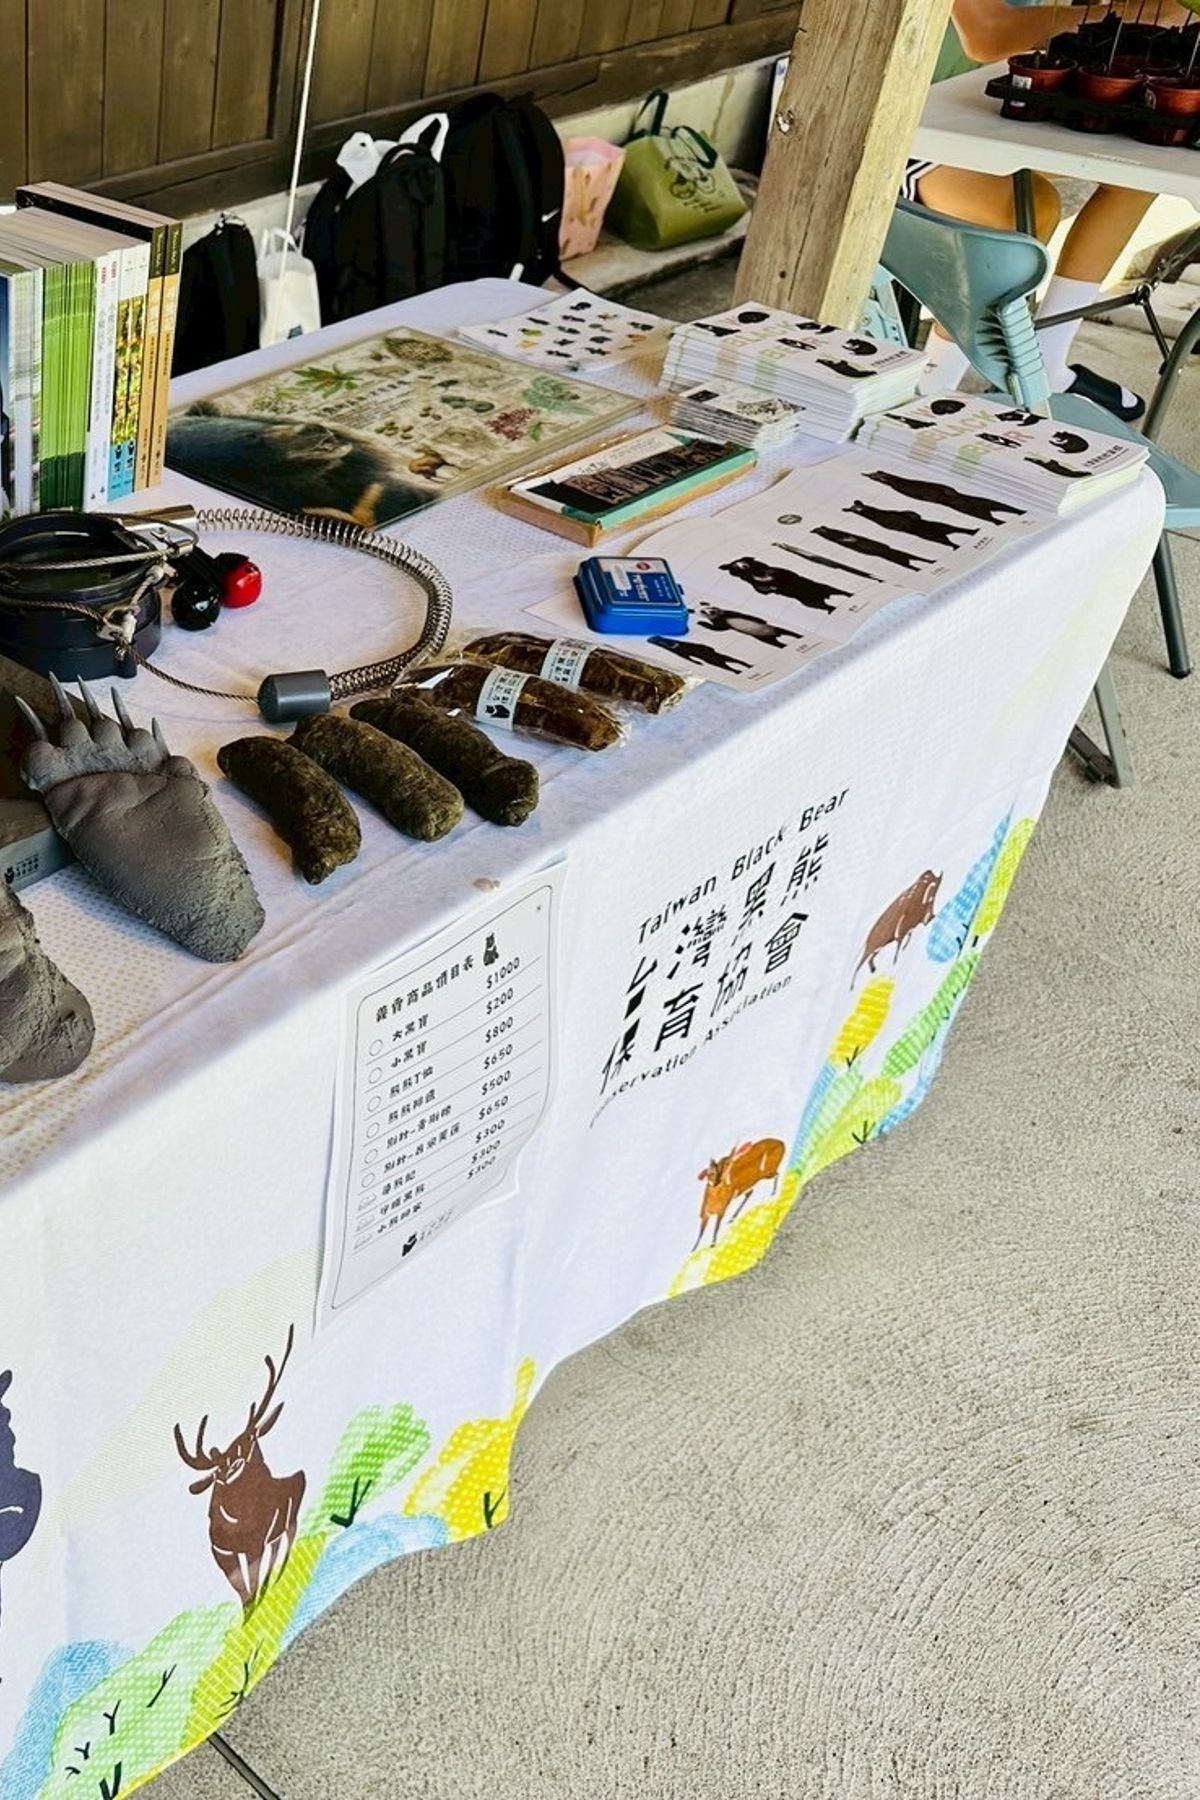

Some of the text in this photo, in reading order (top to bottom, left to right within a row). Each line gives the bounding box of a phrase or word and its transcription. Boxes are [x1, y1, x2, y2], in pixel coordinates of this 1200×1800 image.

[638, 787, 851, 944] Taiwan Black Bear
[624, 832, 830, 1021] 台灣黑熊
[486, 956, 520, 989] $1000
[486, 987, 514, 1015] $200
[599, 912, 810, 1097] 保育協會
[485, 1016, 514, 1043] $800
[483, 1043, 513, 1070] $650
[481, 1070, 511, 1096] $500
[478, 1095, 509, 1120] $650
[475, 1119, 505, 1144] $300
